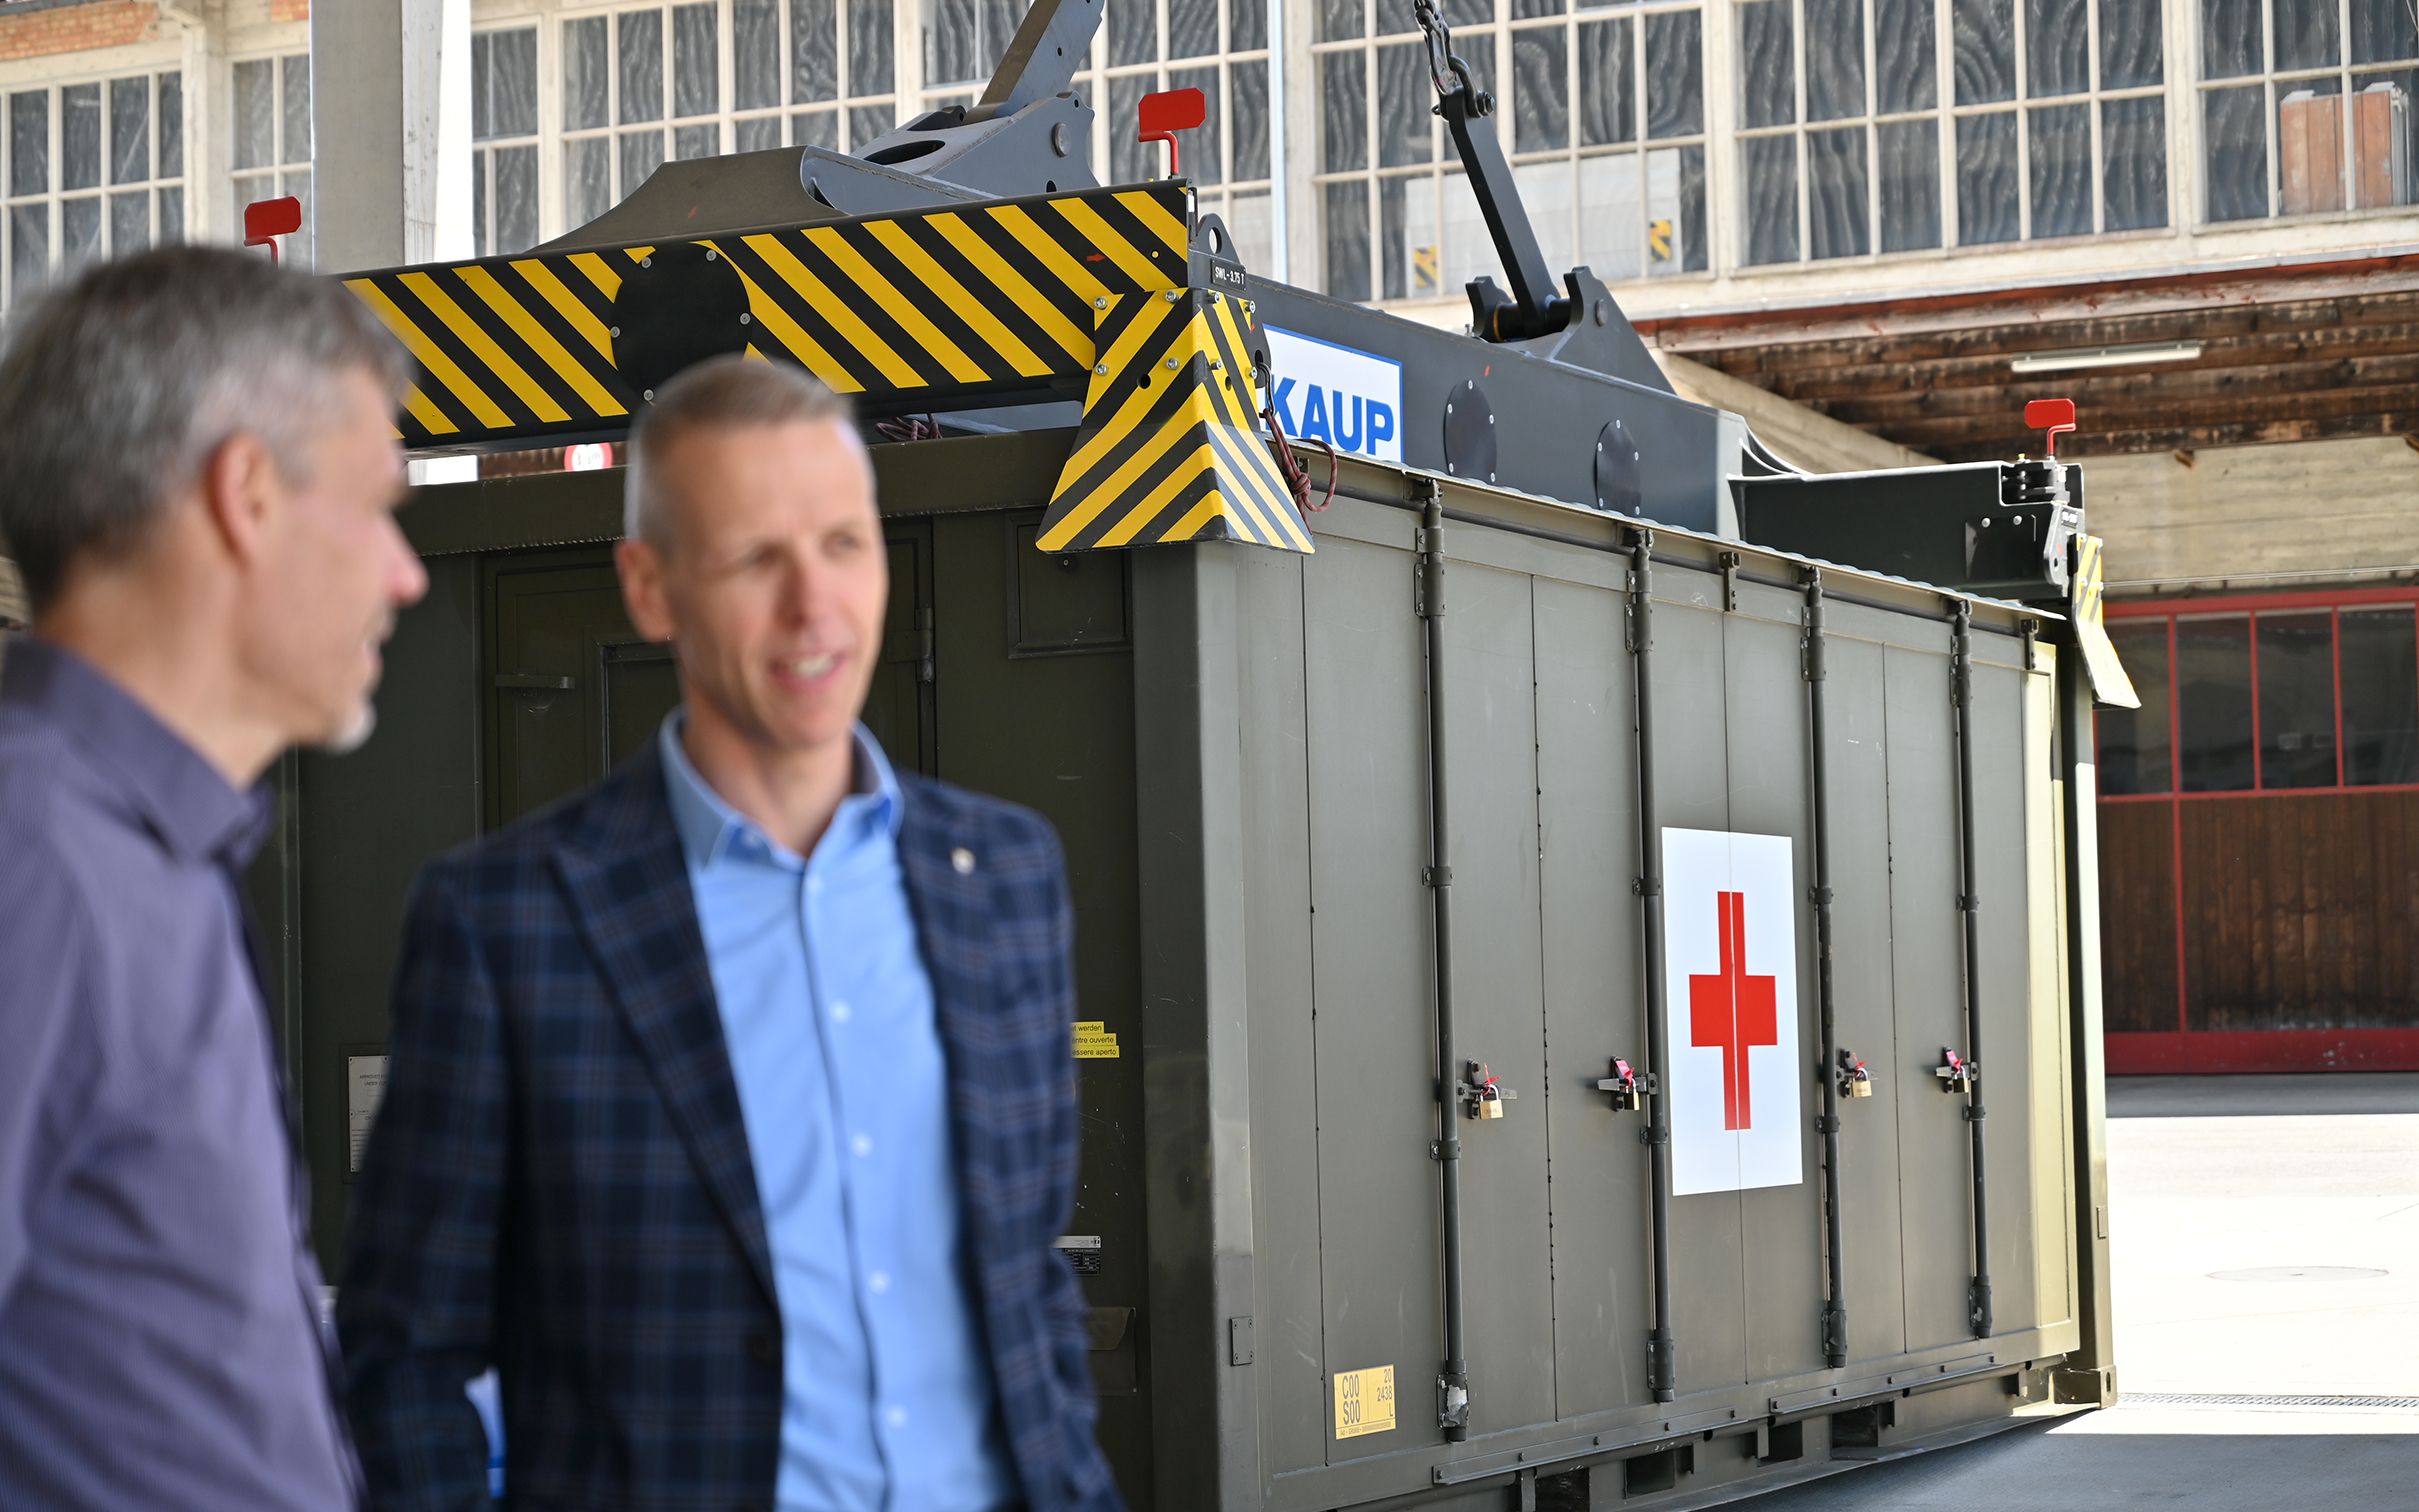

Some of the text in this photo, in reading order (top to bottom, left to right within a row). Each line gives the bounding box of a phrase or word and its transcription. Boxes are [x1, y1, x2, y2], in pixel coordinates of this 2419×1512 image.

[1265, 374, 1395, 456] KAUP
[1078, 1024, 1102, 1032] werden
[1089, 1036, 1114, 1044] ouverte
[1096, 1048, 1117, 1056] aperto
[1384, 1368, 1392, 1384] 20
[1376, 1385, 1393, 1402] 2438
[1389, 1403, 1393, 1417] L
